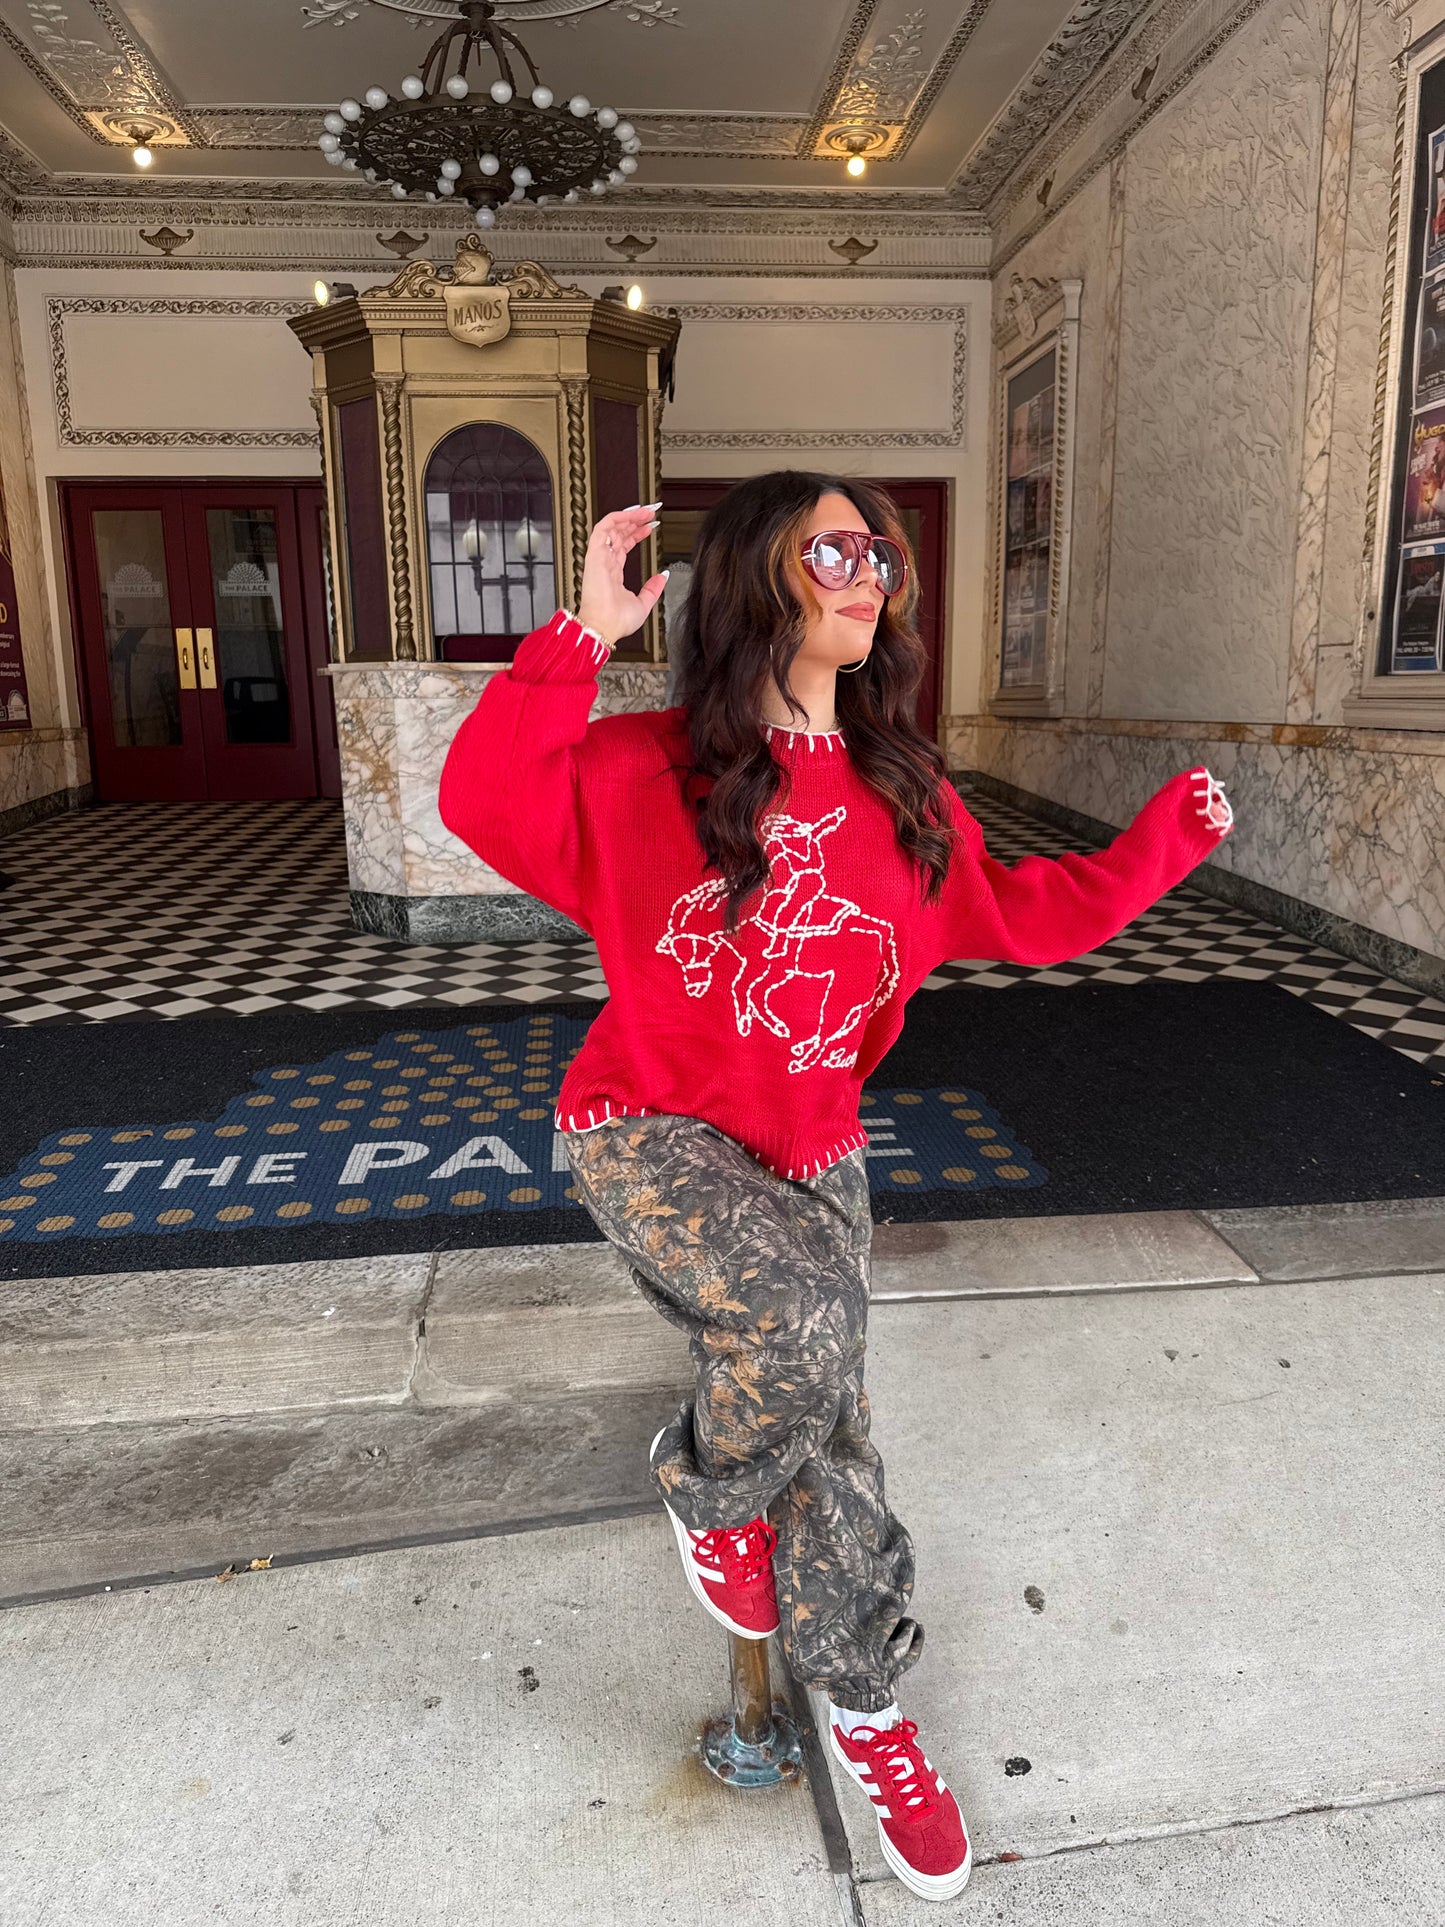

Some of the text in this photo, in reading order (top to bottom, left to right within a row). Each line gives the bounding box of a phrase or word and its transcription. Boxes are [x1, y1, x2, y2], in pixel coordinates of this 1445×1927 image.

[453, 298, 502, 327] MANOS
[124, 585, 156, 593] PALACE
[101, 1152, 307, 1193] THE
